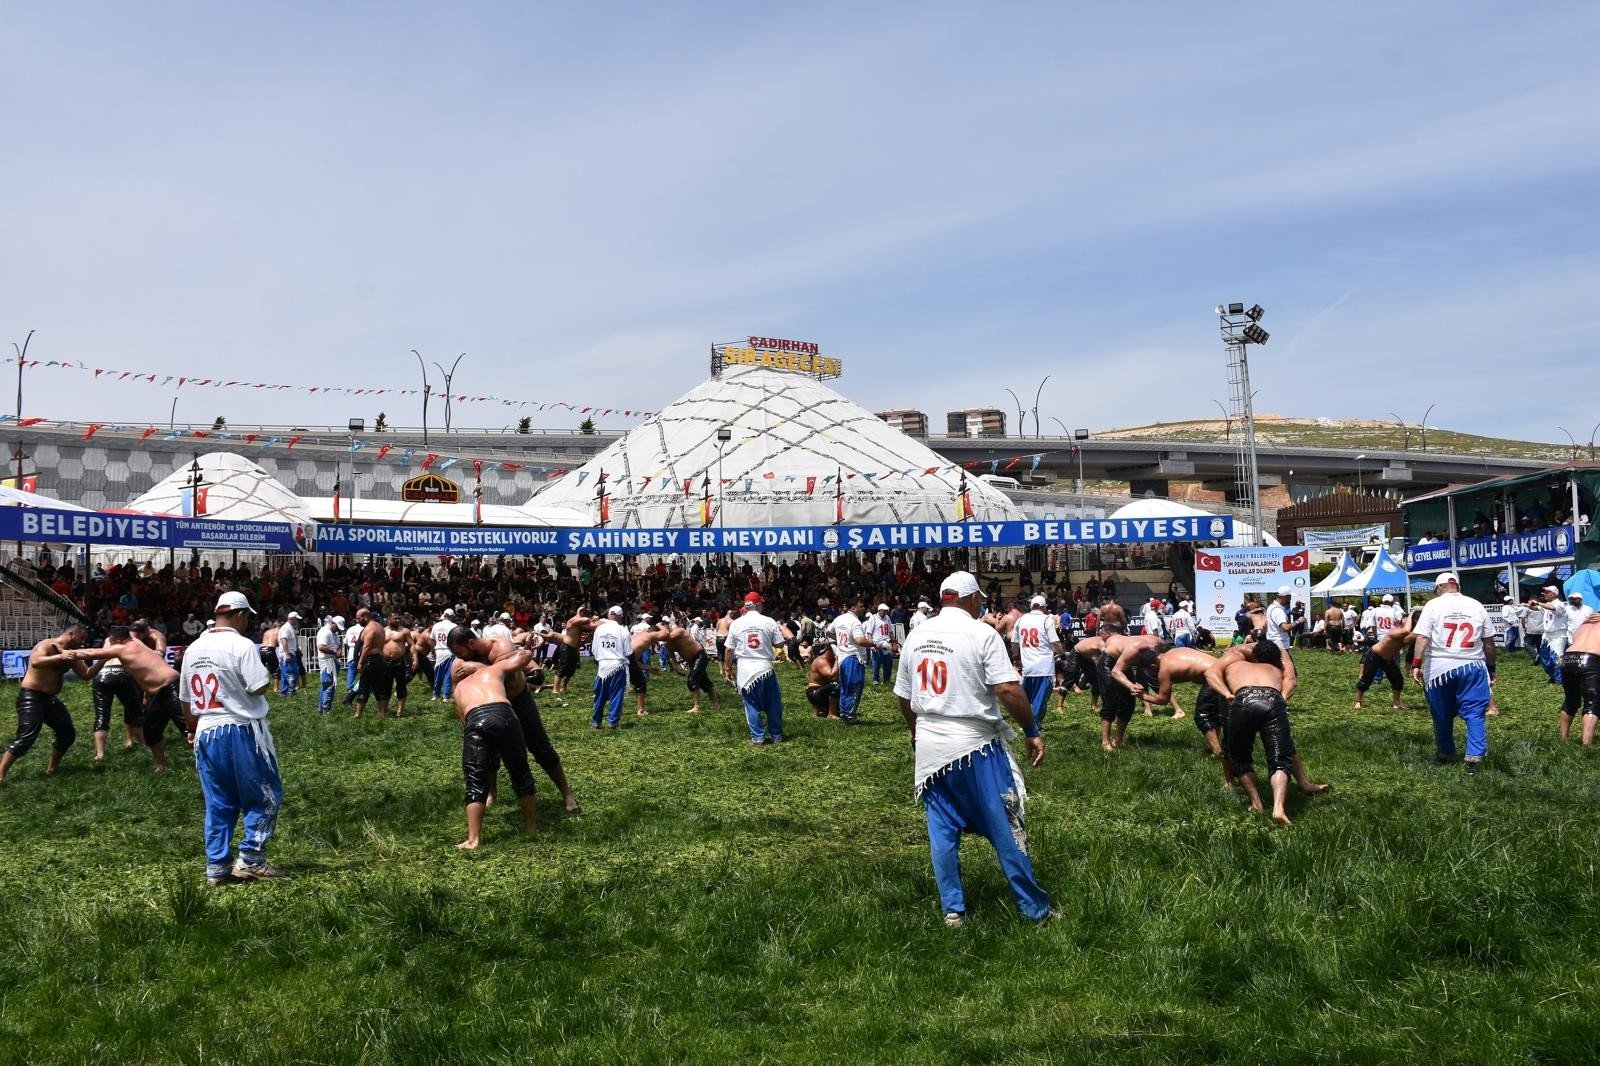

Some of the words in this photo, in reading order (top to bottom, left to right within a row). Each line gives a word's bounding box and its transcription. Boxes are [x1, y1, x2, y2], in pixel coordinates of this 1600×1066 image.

[175, 521, 190, 529] TÜM
[191, 521, 226, 531] ANTRENÖR
[235, 524, 290, 534] SPORCULARIMIZA
[201, 533, 238, 542] BAŞARILAR
[239, 533, 266, 541] DİLERİM
[318, 527, 345, 541] ATA
[348, 528, 446, 544] SPORLARIMIZI
[450, 531, 558, 544] DESTEKLİYORUZ
[848, 524, 1004, 549] ŞAHİNBEY
[1024, 518, 1198, 541] BELEDİYESİ
[568, 531, 679, 550] ŞAHİNBEY
[689, 531, 715, 547] ER
[723, 529, 814, 547] MEYDANI
[1469, 542, 1497, 559] KULE
[1501, 530, 1553, 555] HAKEMİ
[601, 641, 616, 649] 124
[747, 633, 761, 649] 5
[1020, 627, 1040, 648] 28
[1443, 622, 1475, 648] 72
[917, 657, 948, 695] 10
[191, 672, 225, 710] 92
